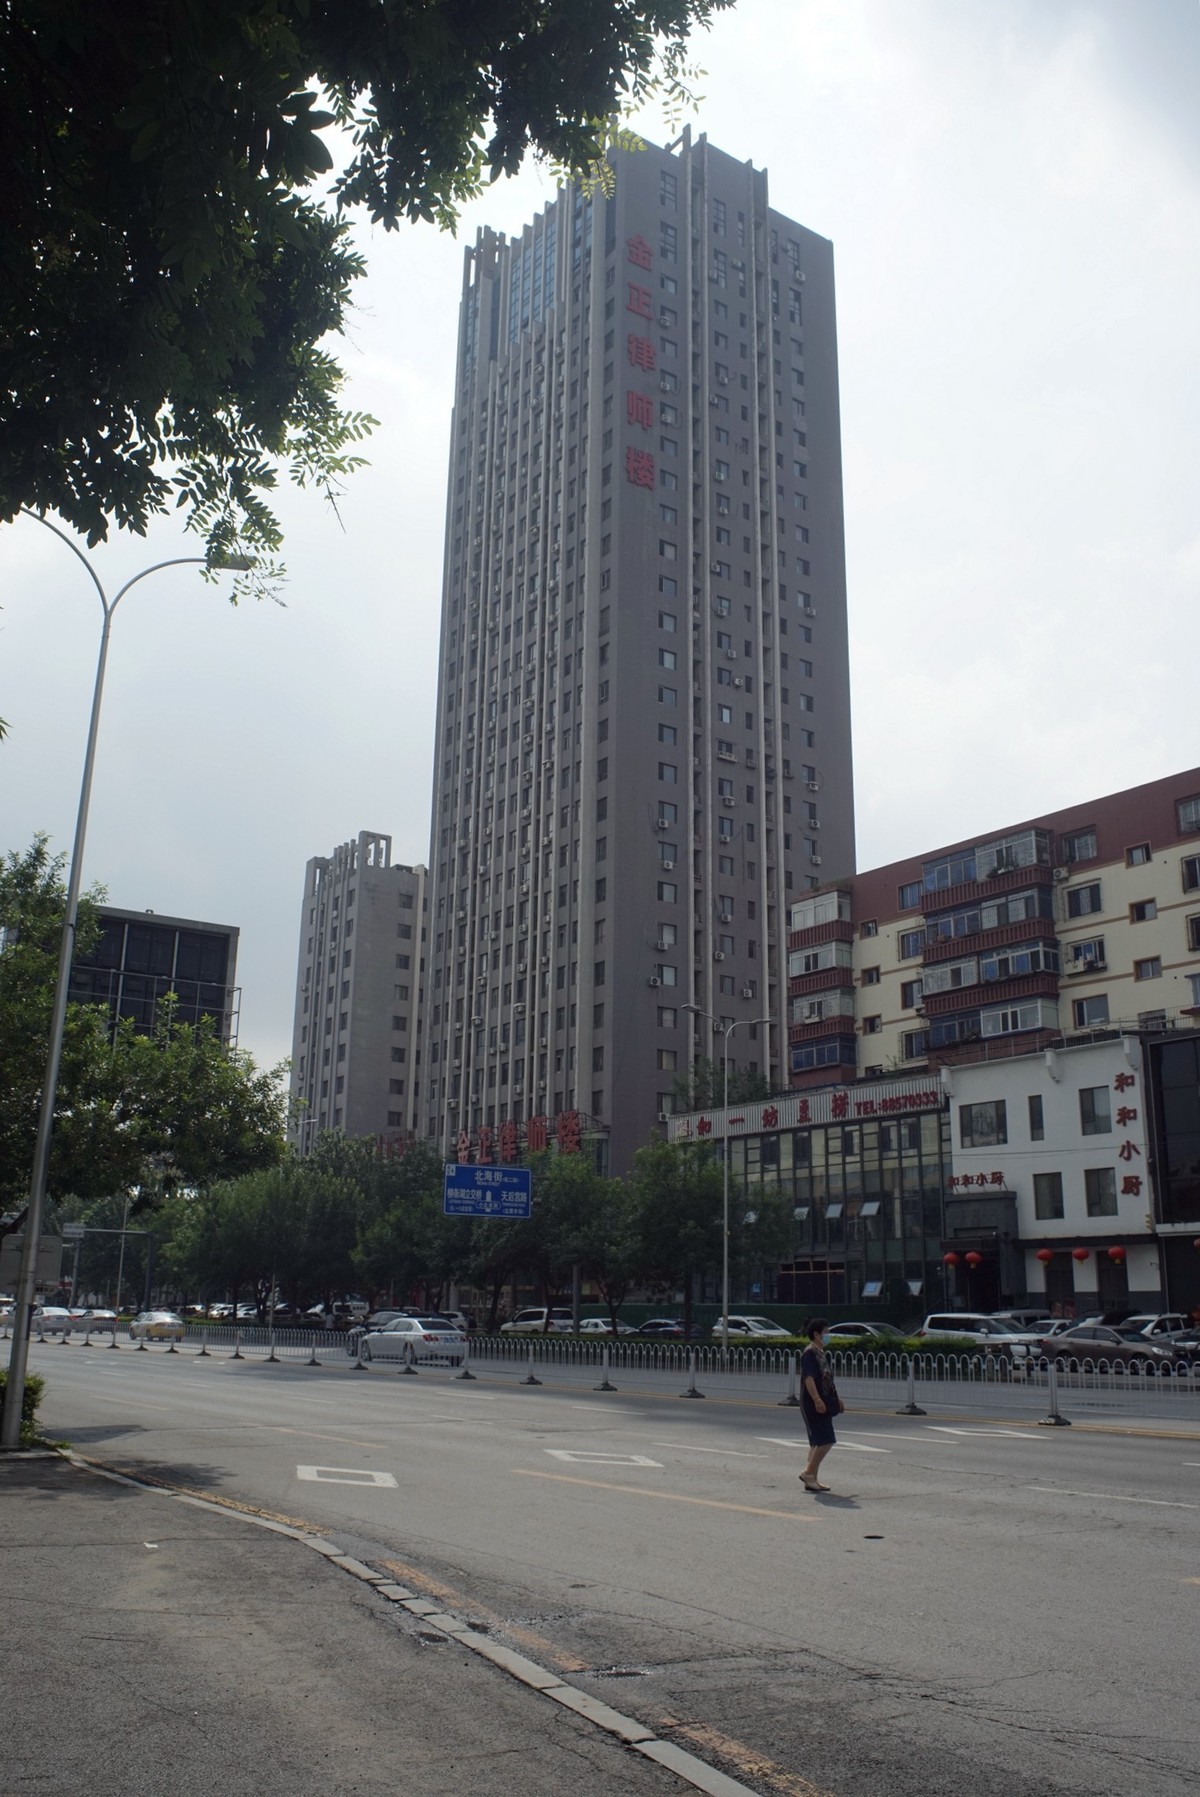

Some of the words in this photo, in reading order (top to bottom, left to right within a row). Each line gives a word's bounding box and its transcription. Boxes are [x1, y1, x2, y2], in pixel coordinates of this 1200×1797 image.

[626, 233, 656, 491] 金正律师楼
[457, 1109, 581, 1164] 金正律师楼
[1114, 1072, 1142, 1197] 和和小厨
[475, 1170, 503, 1182] 北海街
[947, 1171, 1004, 1189] 和和小厨
